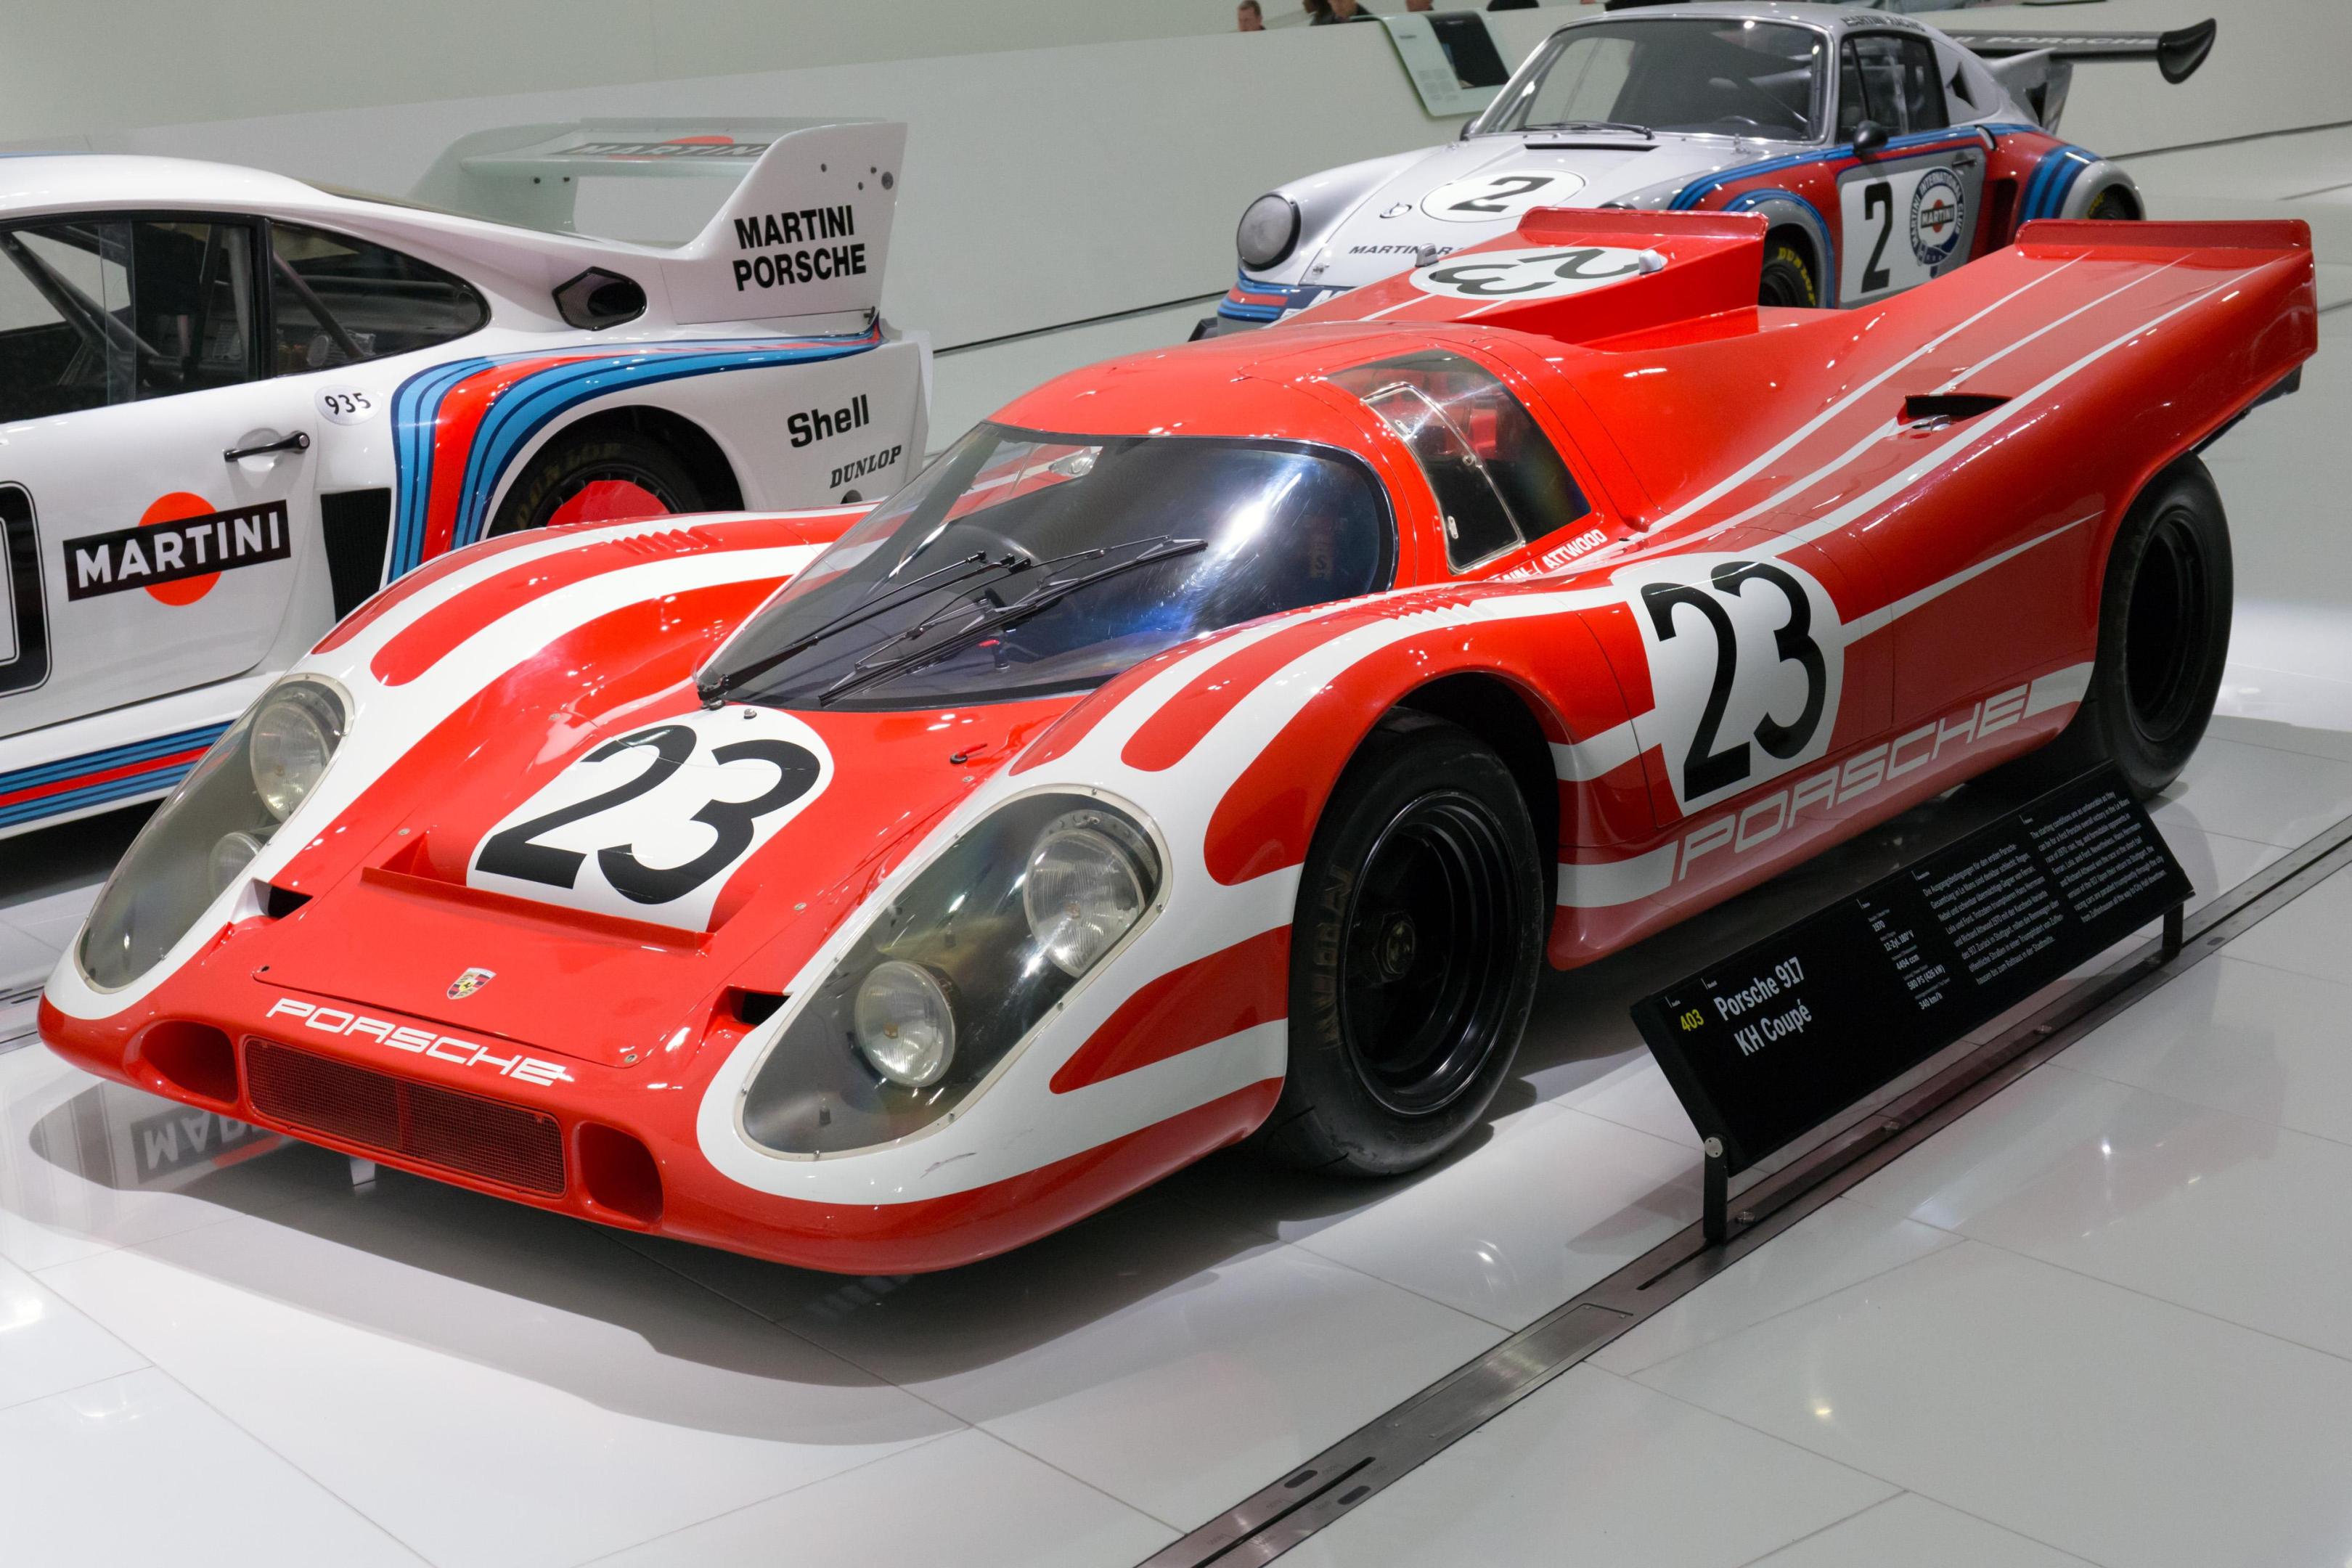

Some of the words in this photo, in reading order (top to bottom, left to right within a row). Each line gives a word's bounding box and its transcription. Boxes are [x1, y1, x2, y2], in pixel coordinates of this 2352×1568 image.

[1986, 36, 2159, 44] PORSCHE
[568, 145, 769, 156] MARTIN
[1448, 176, 1555, 212] 2
[733, 205, 854, 249] MARTINI
[1861, 181, 1893, 293] 2
[1922, 206, 1954, 226] MARTINI
[732, 243, 866, 291] PORSCHE
[1349, 245, 1419, 254] MARTIN
[324, 393, 372, 416] 935
[787, 394, 870, 448] Shell
[829, 444, 902, 489] DUNLOP
[75, 511, 281, 589] MARTINI
[1542, 528, 1608, 570] ATTWOOD
[1641, 561, 1826, 803] 23
[1678, 685, 2028, 880] PORSCHE
[475, 724, 821, 905] 23
[1871, 920, 1886, 932] 1970
[1896, 958, 1910, 970] 4494
[1908, 954, 1920, 964] ccm
[1906, 978, 1918, 991] 580
[1916, 973, 1926, 984] PS
[1923, 968, 1936, 982] (426
[1713, 977, 1780, 1021] Porsche
[1775, 956, 1805, 988] 917
[1919, 998, 1930, 1010] 340
[1928, 992, 1944, 1004] km/h
[1681, 1009, 1704, 1032] 403
[1734, 1024, 1765, 1056] KH
[1760, 998, 1813, 1042] Coupé
[266, 998, 568, 1087] PORSCHE
